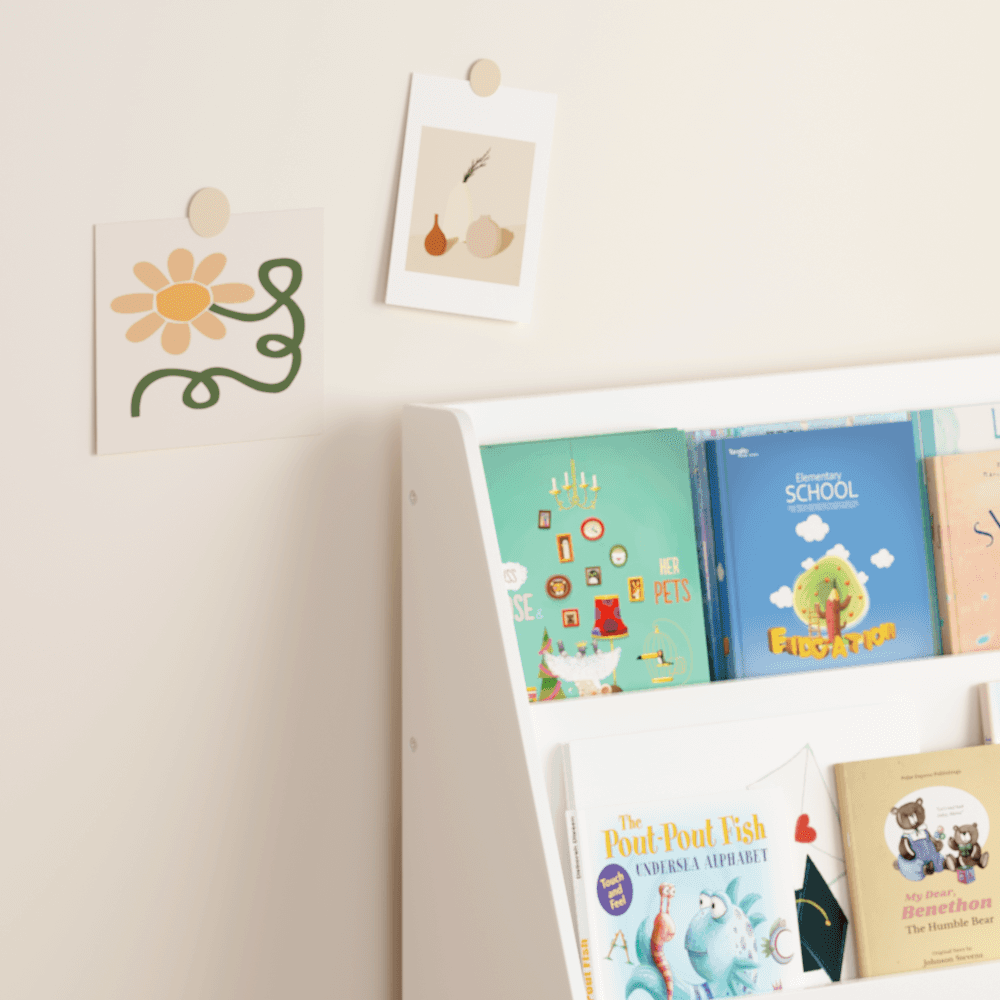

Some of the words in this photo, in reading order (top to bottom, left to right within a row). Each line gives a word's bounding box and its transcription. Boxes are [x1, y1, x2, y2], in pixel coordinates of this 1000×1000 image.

[795, 472, 842, 483] Elementary
[785, 481, 859, 503] SCHOOL
[659, 557, 680, 576] HER
[654, 578, 691, 605] PETS
[509, 593, 535, 622] SE
[618, 814, 642, 831] The
[601, 818, 716, 859] Pout-Pout
[718, 813, 768, 846] Fish
[635, 855, 700, 877] UNDERSEA
[704, 847, 769, 870] ALPHABET
[600, 871, 625, 889] Touch
[608, 884, 624, 899] and
[906, 893, 923, 903] My
[926, 889, 957, 899] Dear,
[609, 895, 627, 910] Feel
[902, 898, 992, 920] Benethon
[905, 923, 926, 934] The
[928, 918, 969, 932] Humble
[971, 916, 994, 926] Bear
